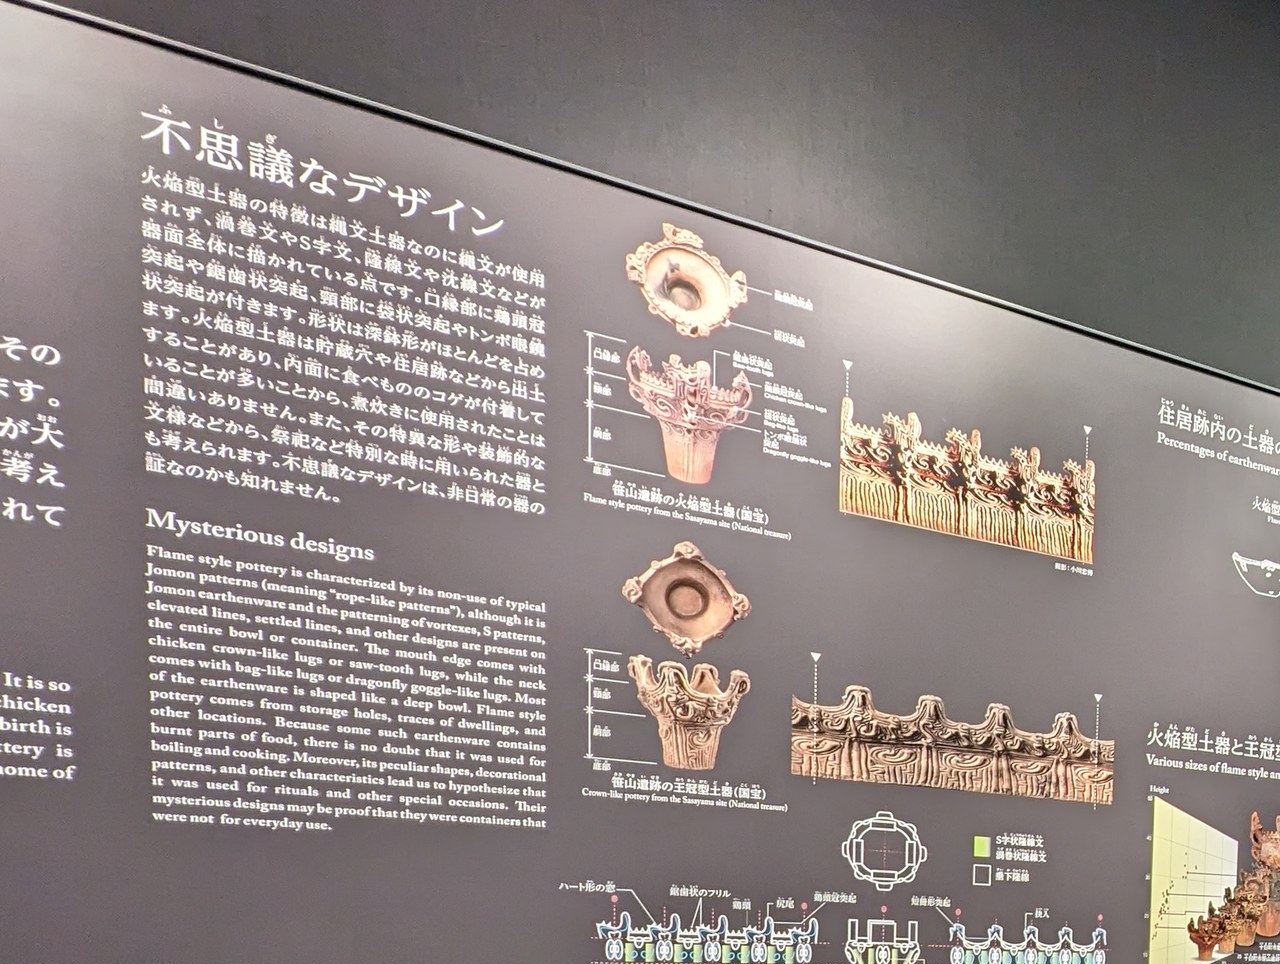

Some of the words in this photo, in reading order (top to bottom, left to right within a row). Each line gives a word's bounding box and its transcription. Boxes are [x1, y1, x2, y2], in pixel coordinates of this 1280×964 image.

[140, 111, 505, 236] 不思議なデザイン
[141, 168, 545, 288] 火焔型土器の特徴は縄文土器なのに縄文が使用
[0, 336, 61, 365] その
[141, 326, 545, 424] することがあり、内面に食べもののコゲが付着して
[141, 353, 545, 447] いることが多いことから、煮炊きに使用されたことは
[0, 416, 64, 449] が大
[141, 377, 545, 470] 間違いありません。また、その特異な形や装飾的な
[1157, 432, 1215, 458] Percentages
[1217, 450, 1228, 461] of
[0, 456, 66, 488] 考え
[141, 430, 545, 515] も考えられます。不思議なデザインは、非日常の器の
[145, 455, 341, 502] 証なのかも知れません。
[2, 497, 66, 527] れて
[583, 492, 607, 505] Flame
[608, 499, 625, 509] style
[626, 503, 652, 515] pottery
[653, 506, 671, 517] from
[672, 510, 684, 519] the
[684, 512, 718, 526] Sasayama
[718, 520, 730, 528] site
[731, 522, 763, 535] (National
[763, 529, 792, 541] treasure)
[145, 508, 284, 547] Mysterious
[290, 532, 374, 562] designs
[146, 544, 194, 562] Flame
[198, 555, 232, 568] style
[235, 561, 288, 578] pottery
[291, 566, 303, 577] is
[306, 569, 396, 591] characterized
[399, 581, 415, 596] by
[418, 585, 434, 596] its
[437, 590, 487, 604] non-use
[489, 596, 504, 606] of
[505, 600, 546, 613] typical
[144, 563, 195, 580] Jomon
[198, 573, 258, 588] patterns
[261, 578, 327, 601] (meaning
[329, 588, 395, 607] “rope-like
[398, 601, 465, 618] patterns”),
[467, 608, 522, 626] although
[524, 616, 534, 627] it
[536, 618, 546, 628] is
[147, 617, 172, 630] the
[179, 623, 222, 635] entire
[228, 626, 264, 640] bowl
[269, 635, 286, 643] or
[290, 637, 358, 652] container.
[363, 642, 389, 656] The
[395, 650, 437, 661] mouth
[442, 653, 471, 668] edge
[476, 660, 514, 671] comes
[518, 664, 546, 675] with
[3, 672, 22, 688] It
[27, 675, 44, 689] is
[48, 680, 71, 692] so
[0, 694, 72, 714] hicken
[0, 716, 51, 735] birth
[55, 722, 72, 736] is
[0, 742, 44, 759] tery
[56, 744, 73, 758] is
[1146, 754, 1184, 768] Various
[1185, 759, 1208, 771] sizes
[1209, 762, 1221, 772] of
[1221, 763, 1246, 775] flame
[1248, 767, 1268, 780] style
[52, 765, 77, 780] of
[581, 787, 623, 799] Crown-like
[624, 793, 650, 803] pottery
[651, 793, 668, 802] from
[669, 794, 681, 803] the
[682, 796, 714, 807] Sasayama
[715, 799, 728, 807] site
[728, 799, 760, 809] (National
[760, 804, 788, 812] treasure)
[1150, 785, 1169, 794] Height
